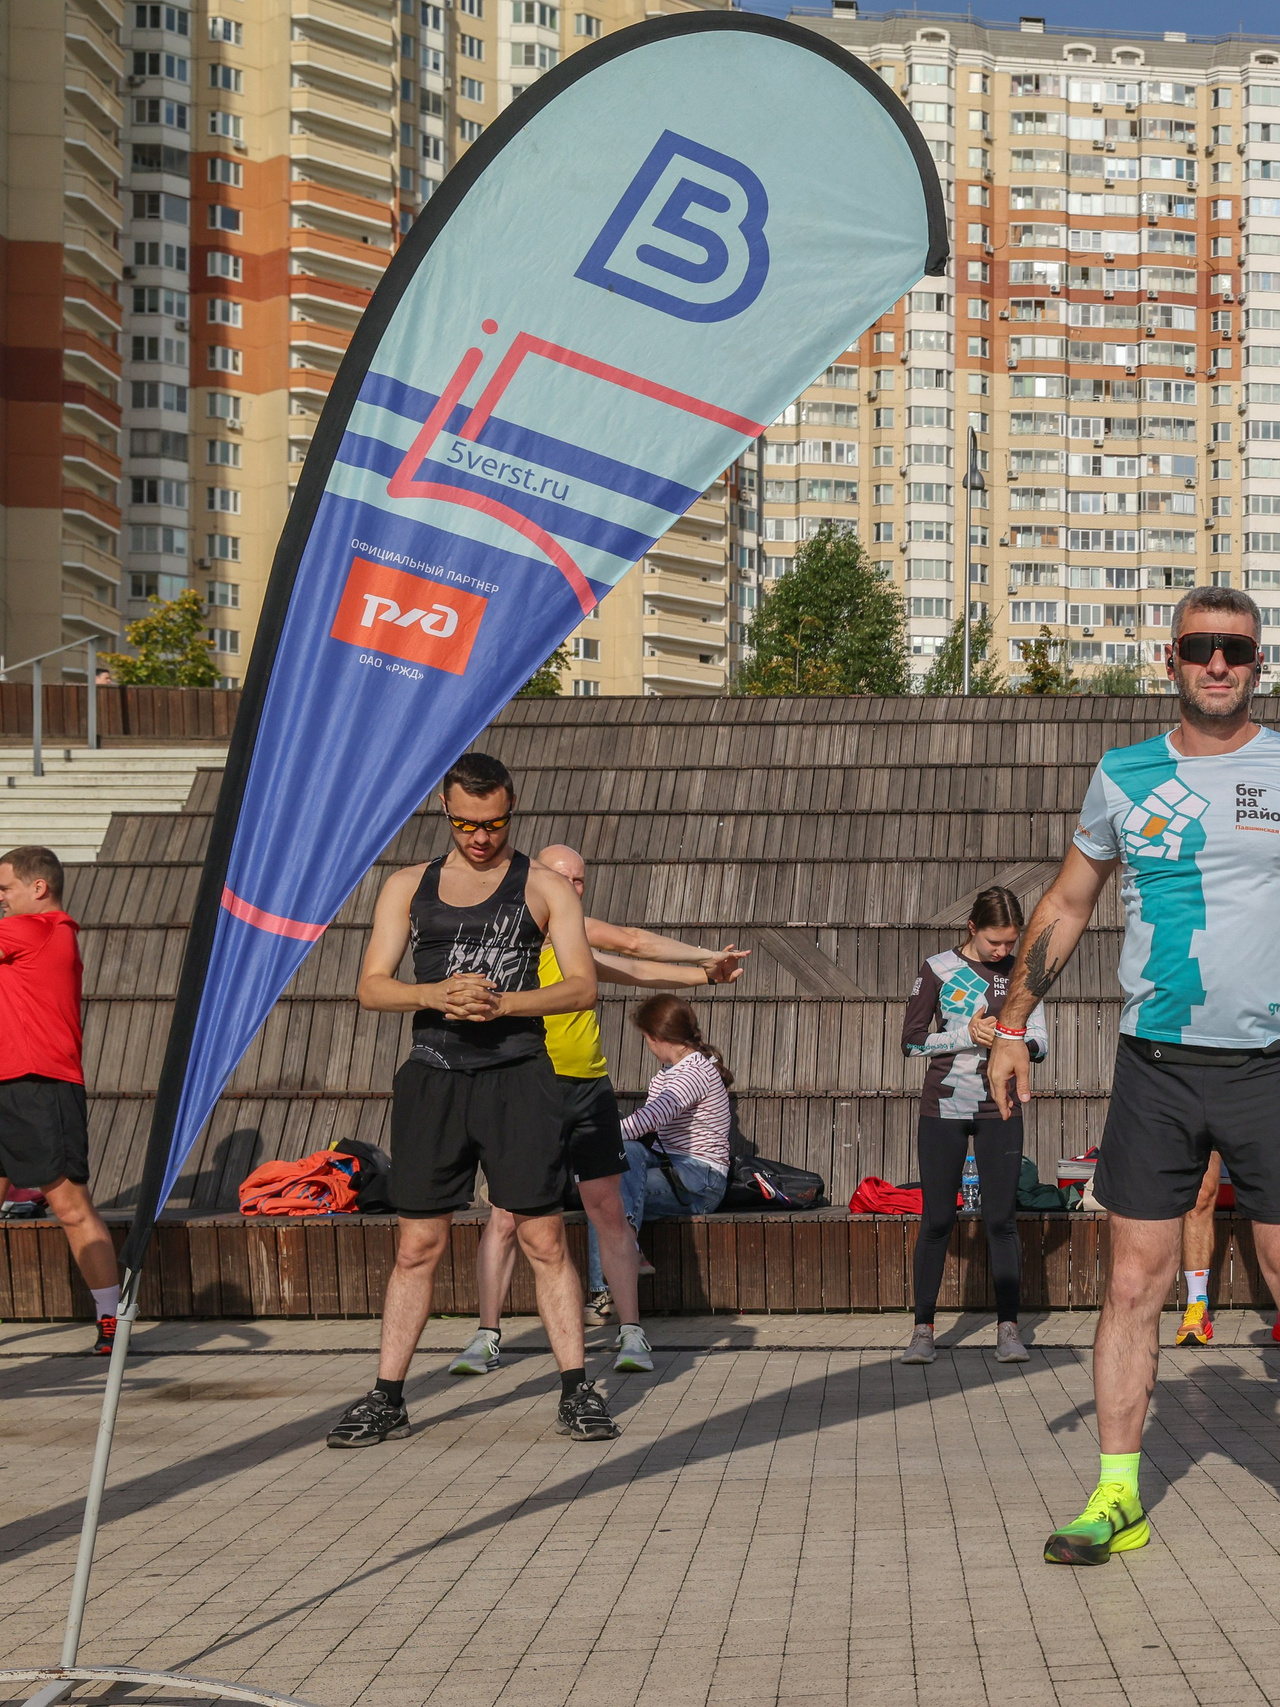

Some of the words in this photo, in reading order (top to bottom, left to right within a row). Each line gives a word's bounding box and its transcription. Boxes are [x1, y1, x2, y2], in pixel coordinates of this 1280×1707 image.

[446, 440, 570, 501] 5verst.ru
[351, 538, 444, 578] ОФИЦИАЛЬНЫЙ
[446, 570, 500, 595] ПАРТНЕР
[359, 654, 383, 668] ОАО
[385, 663, 424, 681] «РЖД»
[1235, 783, 1267, 797] бег
[1235, 798, 1258, 807] на
[993, 974, 1010, 984] бег
